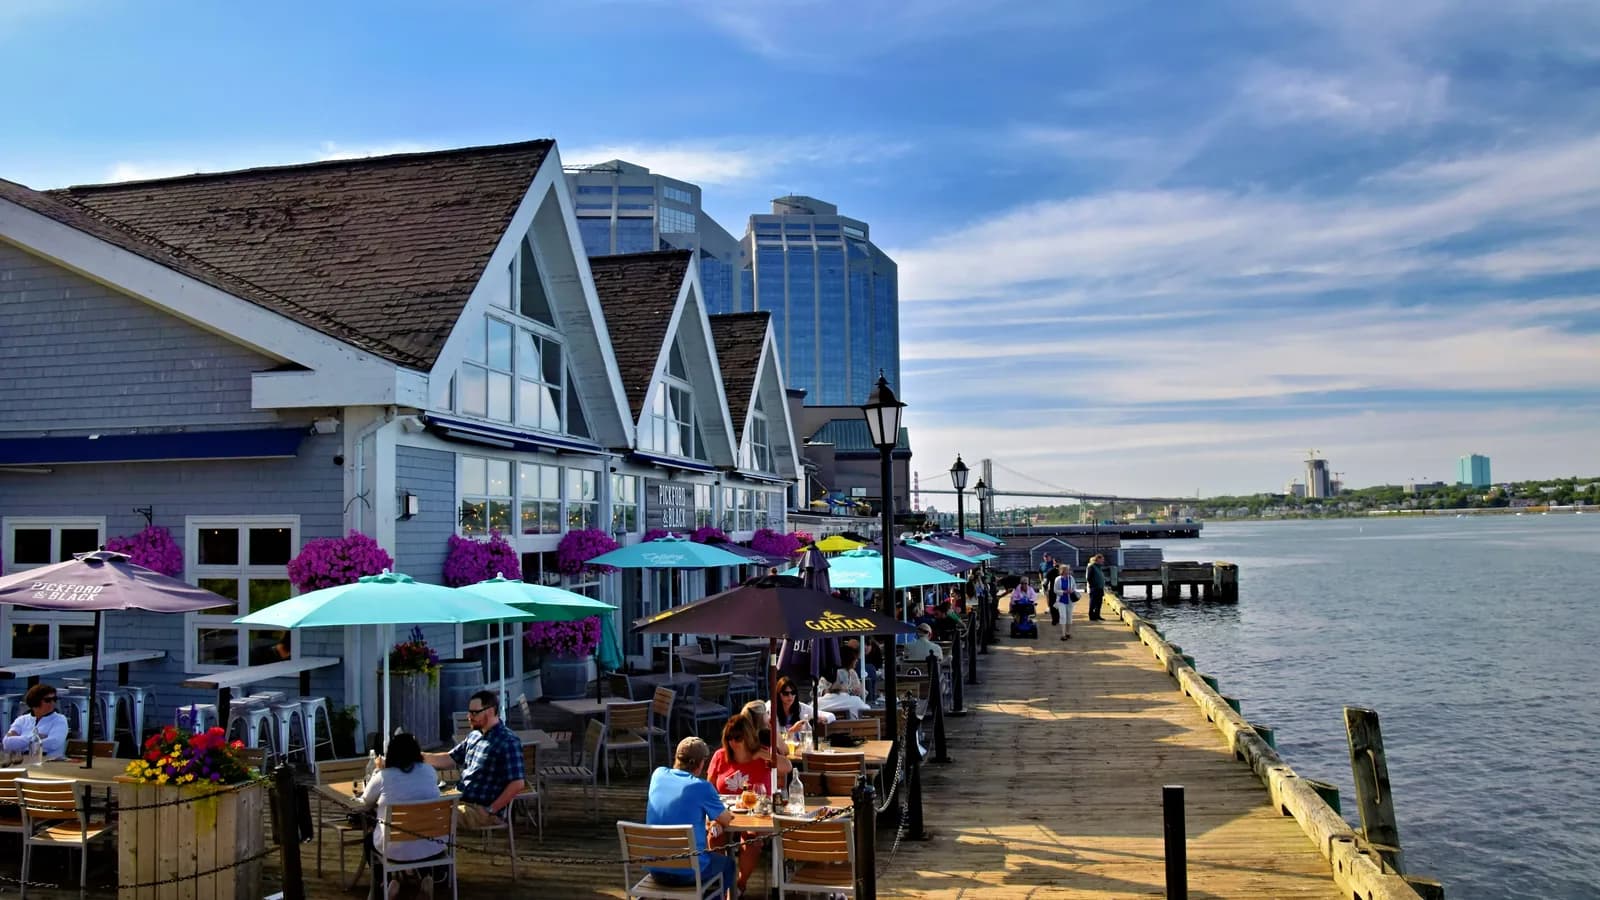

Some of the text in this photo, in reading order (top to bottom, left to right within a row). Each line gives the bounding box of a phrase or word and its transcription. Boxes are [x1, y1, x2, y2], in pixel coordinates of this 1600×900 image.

[658, 484, 686, 506] PICKFORD
[669, 507, 687, 528] BLACK
[31, 581, 104, 594] PICKFORD
[32, 590, 99, 601] & BLACK
[805, 618, 877, 631] GAHAN
